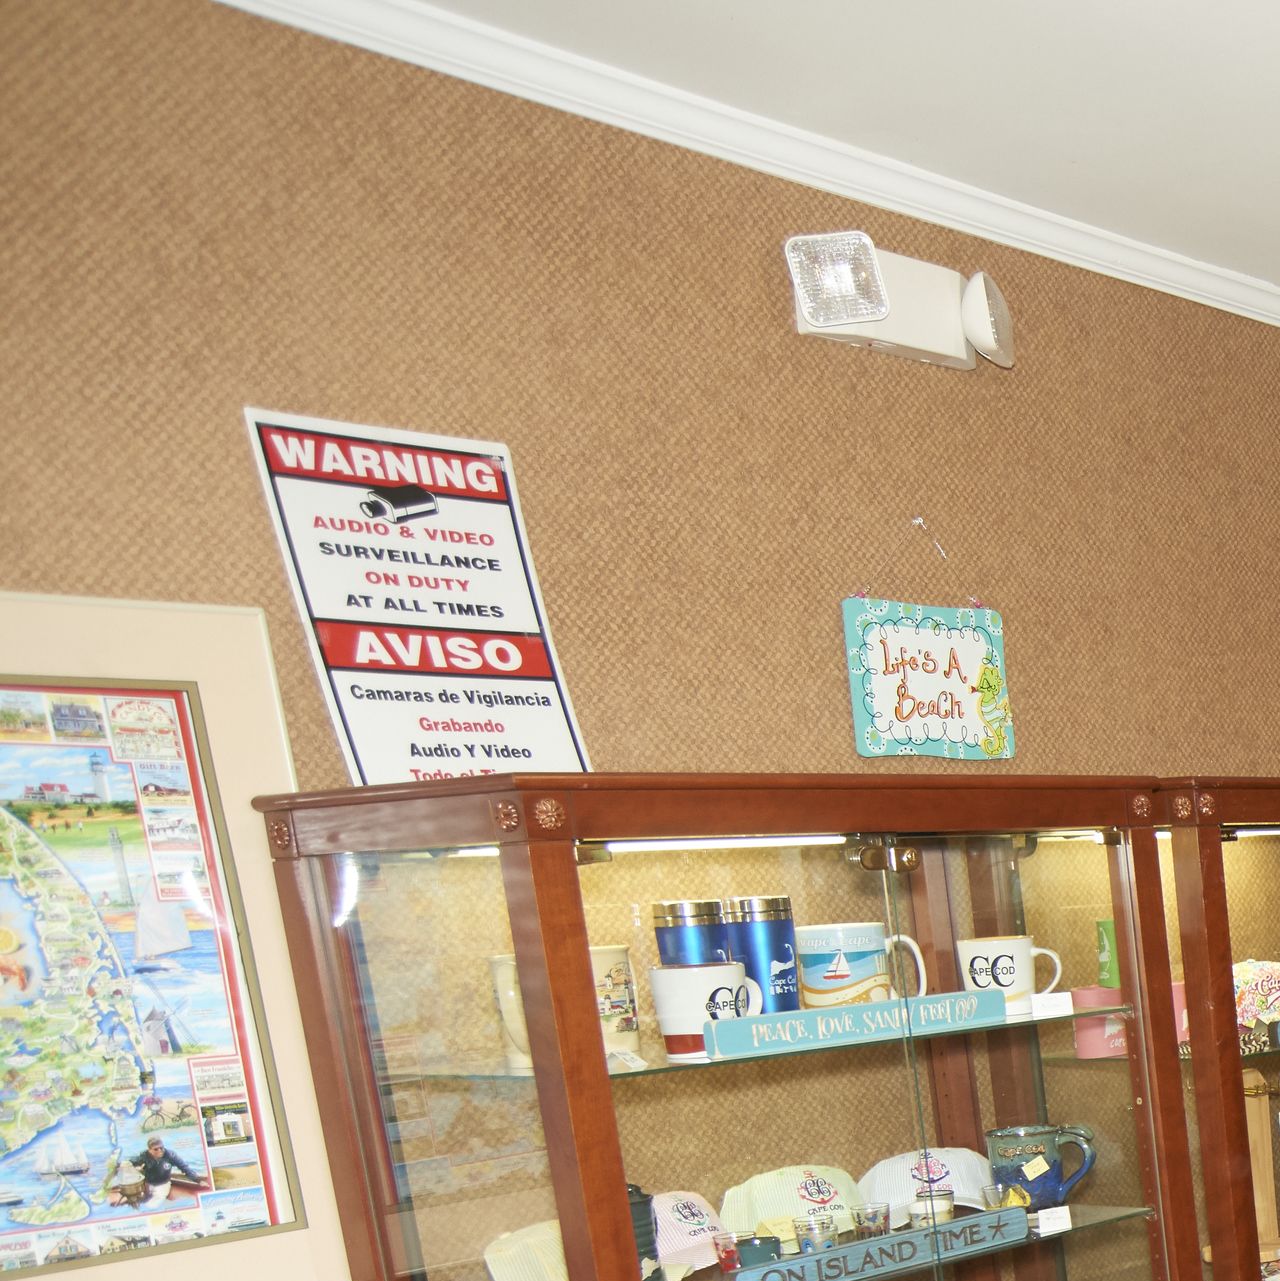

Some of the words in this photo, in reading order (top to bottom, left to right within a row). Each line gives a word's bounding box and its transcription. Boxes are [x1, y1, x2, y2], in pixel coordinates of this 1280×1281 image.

[271, 433, 499, 493] WARNING
[313, 515, 390, 536] AUDIO
[399, 525, 415, 538] &
[424, 528, 494, 547] VIDEO
[319, 542, 501, 571] SURVEILLANCE
[365, 571, 399, 586] ON
[408, 575, 470, 592] DUTY
[346, 594, 373, 607] AT
[384, 597, 427, 613] ALL
[433, 601, 504, 618] TIMES
[356, 631, 523, 671] AVISO
[944, 648, 967, 683] A
[350, 684, 434, 703] Camaras
[439, 688, 459, 703] de
[464, 690, 551, 707] Vigilancia
[419, 717, 504, 733] Grabando
[410, 743, 461, 758] Audio
[464, 745, 476, 758] Y
[481, 745, 532, 758] Video
[968, 967, 991, 977] CAPE
[994, 966, 1016, 976] COD
[705, 999, 735, 1012] CAPE
[863, 1004, 915, 1034] SANDY
[920, 999, 954, 1025] FEET
[998, 1146, 1022, 1159] Cape
[1025, 1144, 1046, 1154] Cod
[807, 1205, 828, 1216] CAPE
[924, 1223, 987, 1253] TIME
